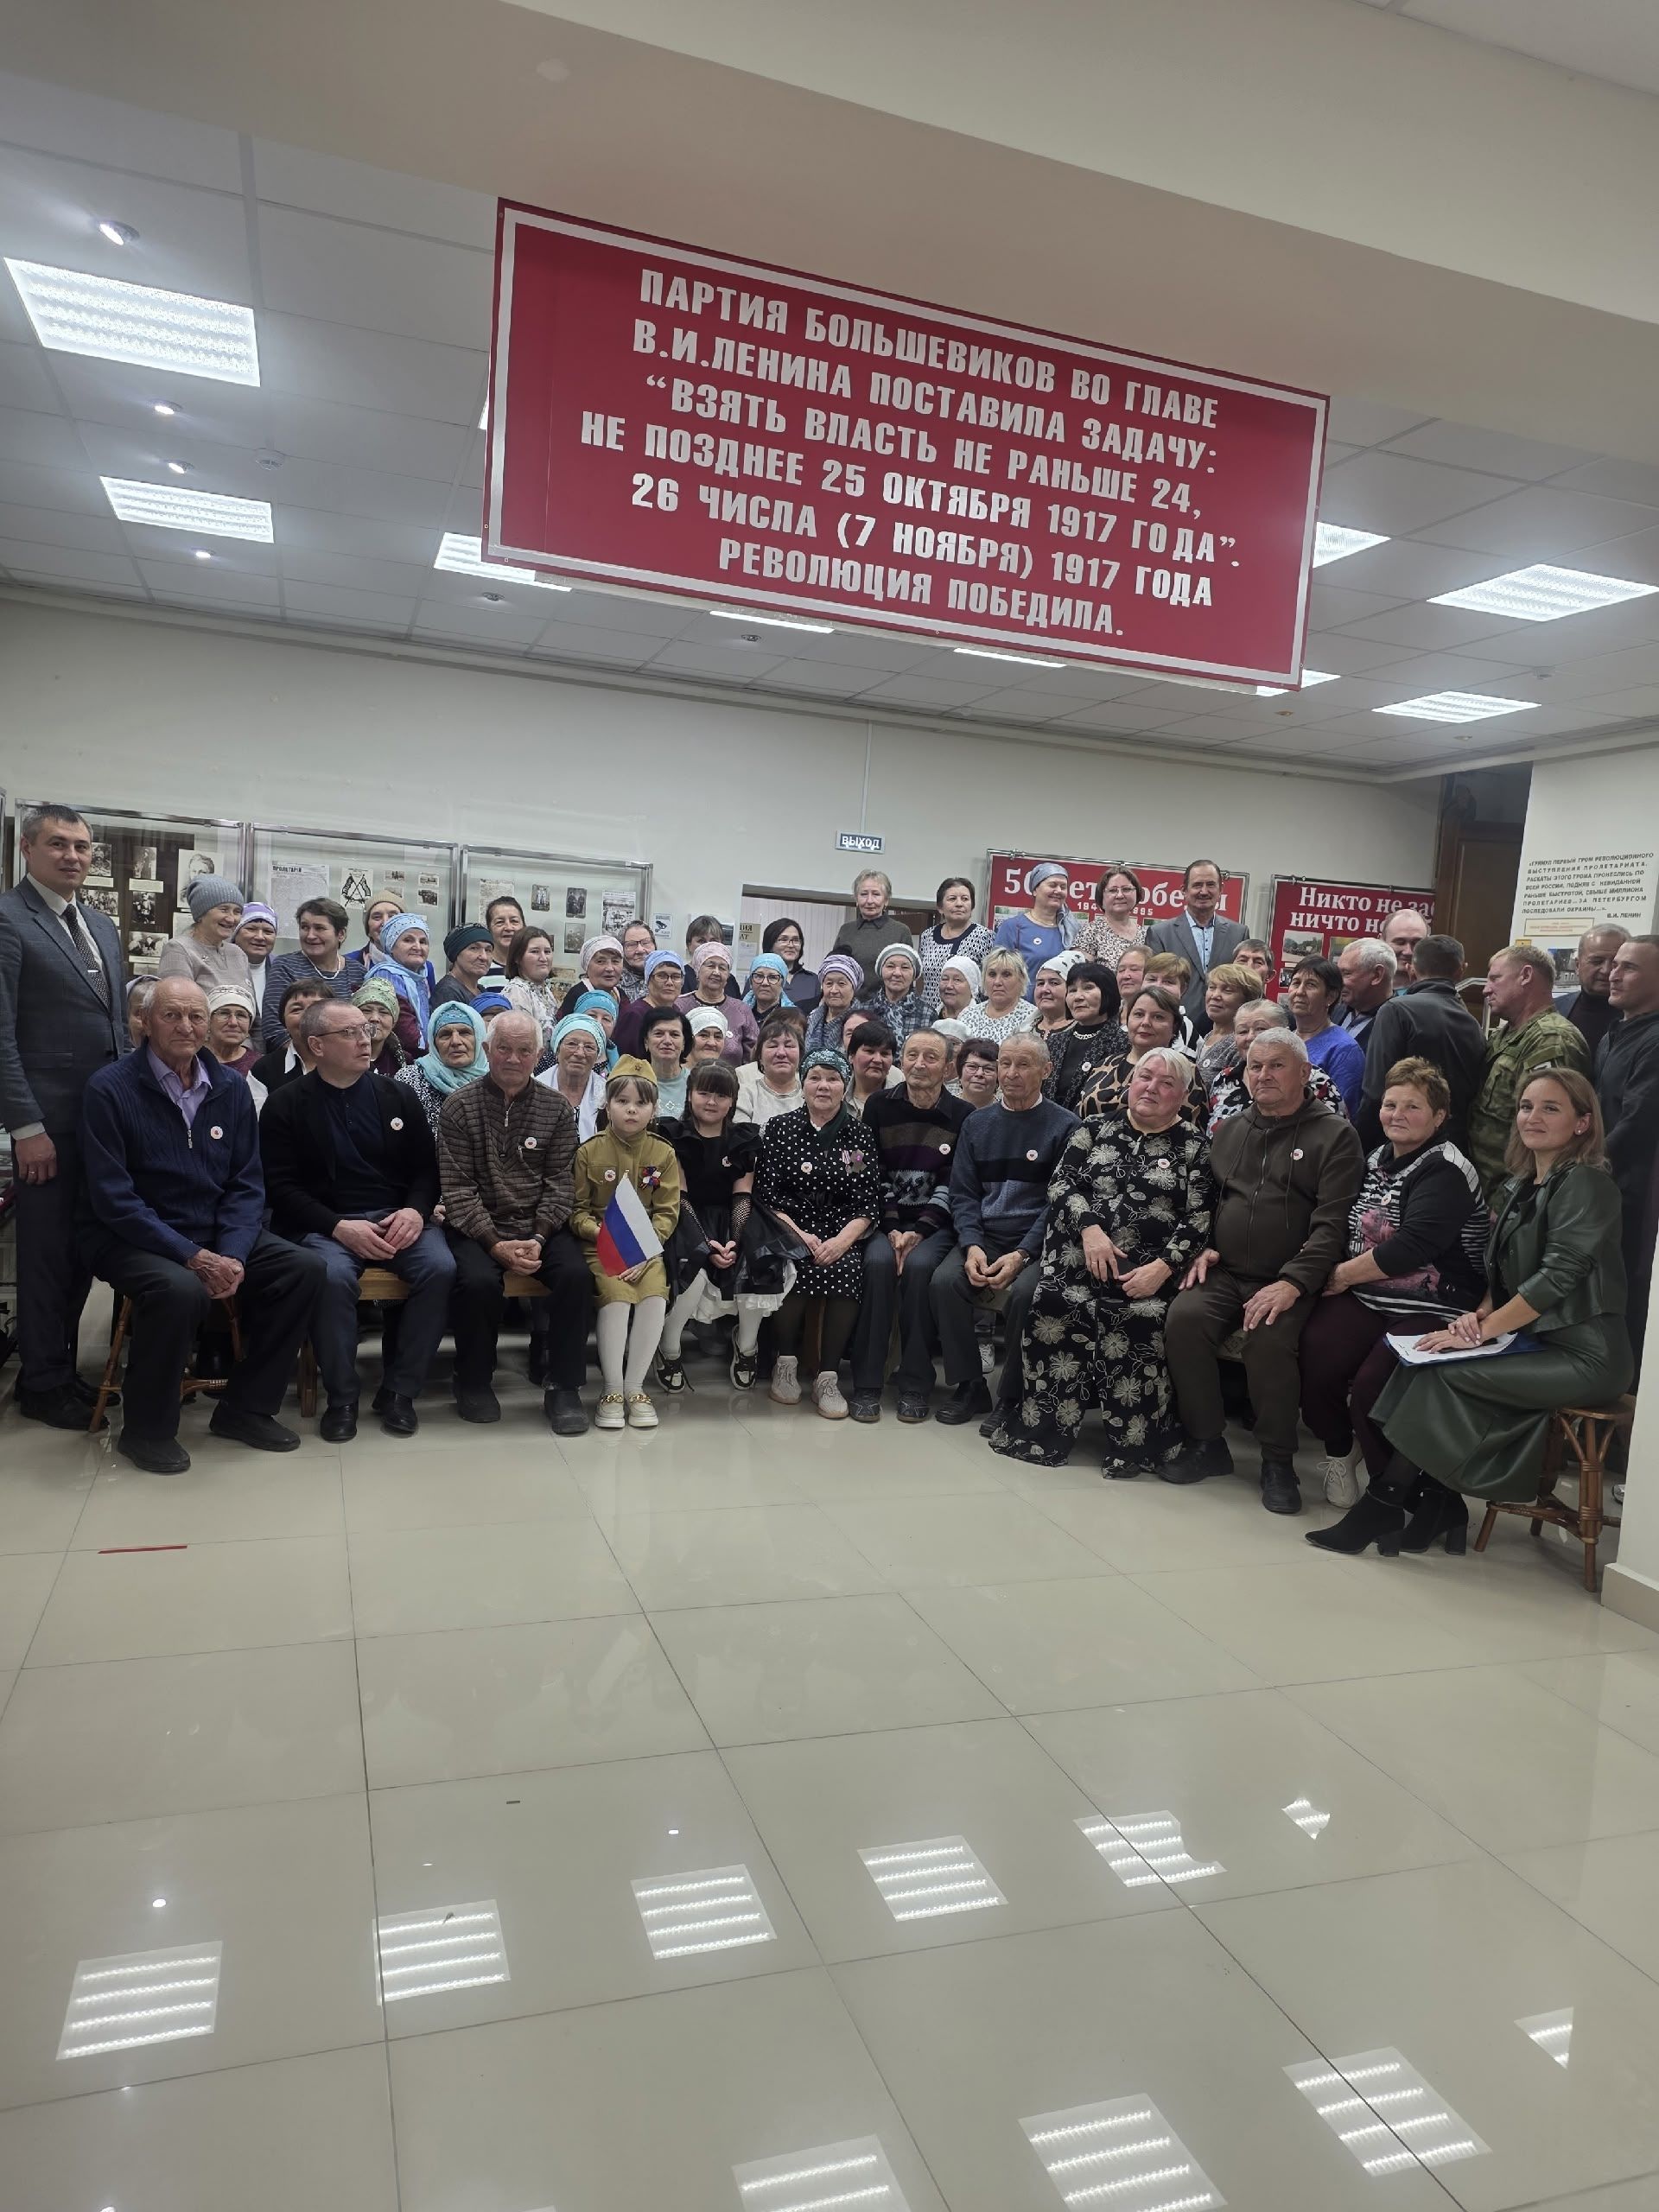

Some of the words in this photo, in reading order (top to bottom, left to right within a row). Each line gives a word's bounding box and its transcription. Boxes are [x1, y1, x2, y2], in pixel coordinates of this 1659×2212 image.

[633, 319, 851, 398] В.И.ЛЕНИНА
[870, 372, 1065, 442] ПОСТАВИЛА
[1082, 418, 1216, 473] ЗАДАЧУ:
[641, 270, 787, 334] ПАРТИЯ
[805, 308, 1055, 392] БОЛЬШЕВИКОВ
[1071, 369, 1109, 404] ВО
[1125, 381, 1218, 428] ГЛАВЕ
[582, 411, 625, 451] НЕ
[645, 423, 804, 485] ПОЗДНЕЕ
[822, 460, 866, 497] 25
[883, 472, 1031, 528] ОКТЯБРЯ
[1048, 504, 1116, 543] 1917
[804, 408, 937, 462] ВЛАСТЬ
[954, 439, 992, 474] НЕ
[1007, 449, 1137, 502] РАНЬШЕ
[1152, 479, 1201, 519] 24,
[632, 474, 678, 512] 26
[699, 485, 817, 537] ЧИСЛА
[837, 512, 875, 549] (7
[893, 521, 1033, 579] НОЯБРЯ)
[1052, 552, 1120, 589] 1917
[1135, 566, 1211, 607] ГОДА
[720, 538, 931, 604] РЕВОЛЮЦИЯ
[948, 579, 1123, 635] ПОБЕДИЛА.
[842, 836, 880, 849] ВЫХОД
[1069, 880, 1098, 900] ет
[1289, 912, 1360, 931] ничто
[1299, 887, 1371, 912] Никто
[1376, 898, 1402, 914] не
